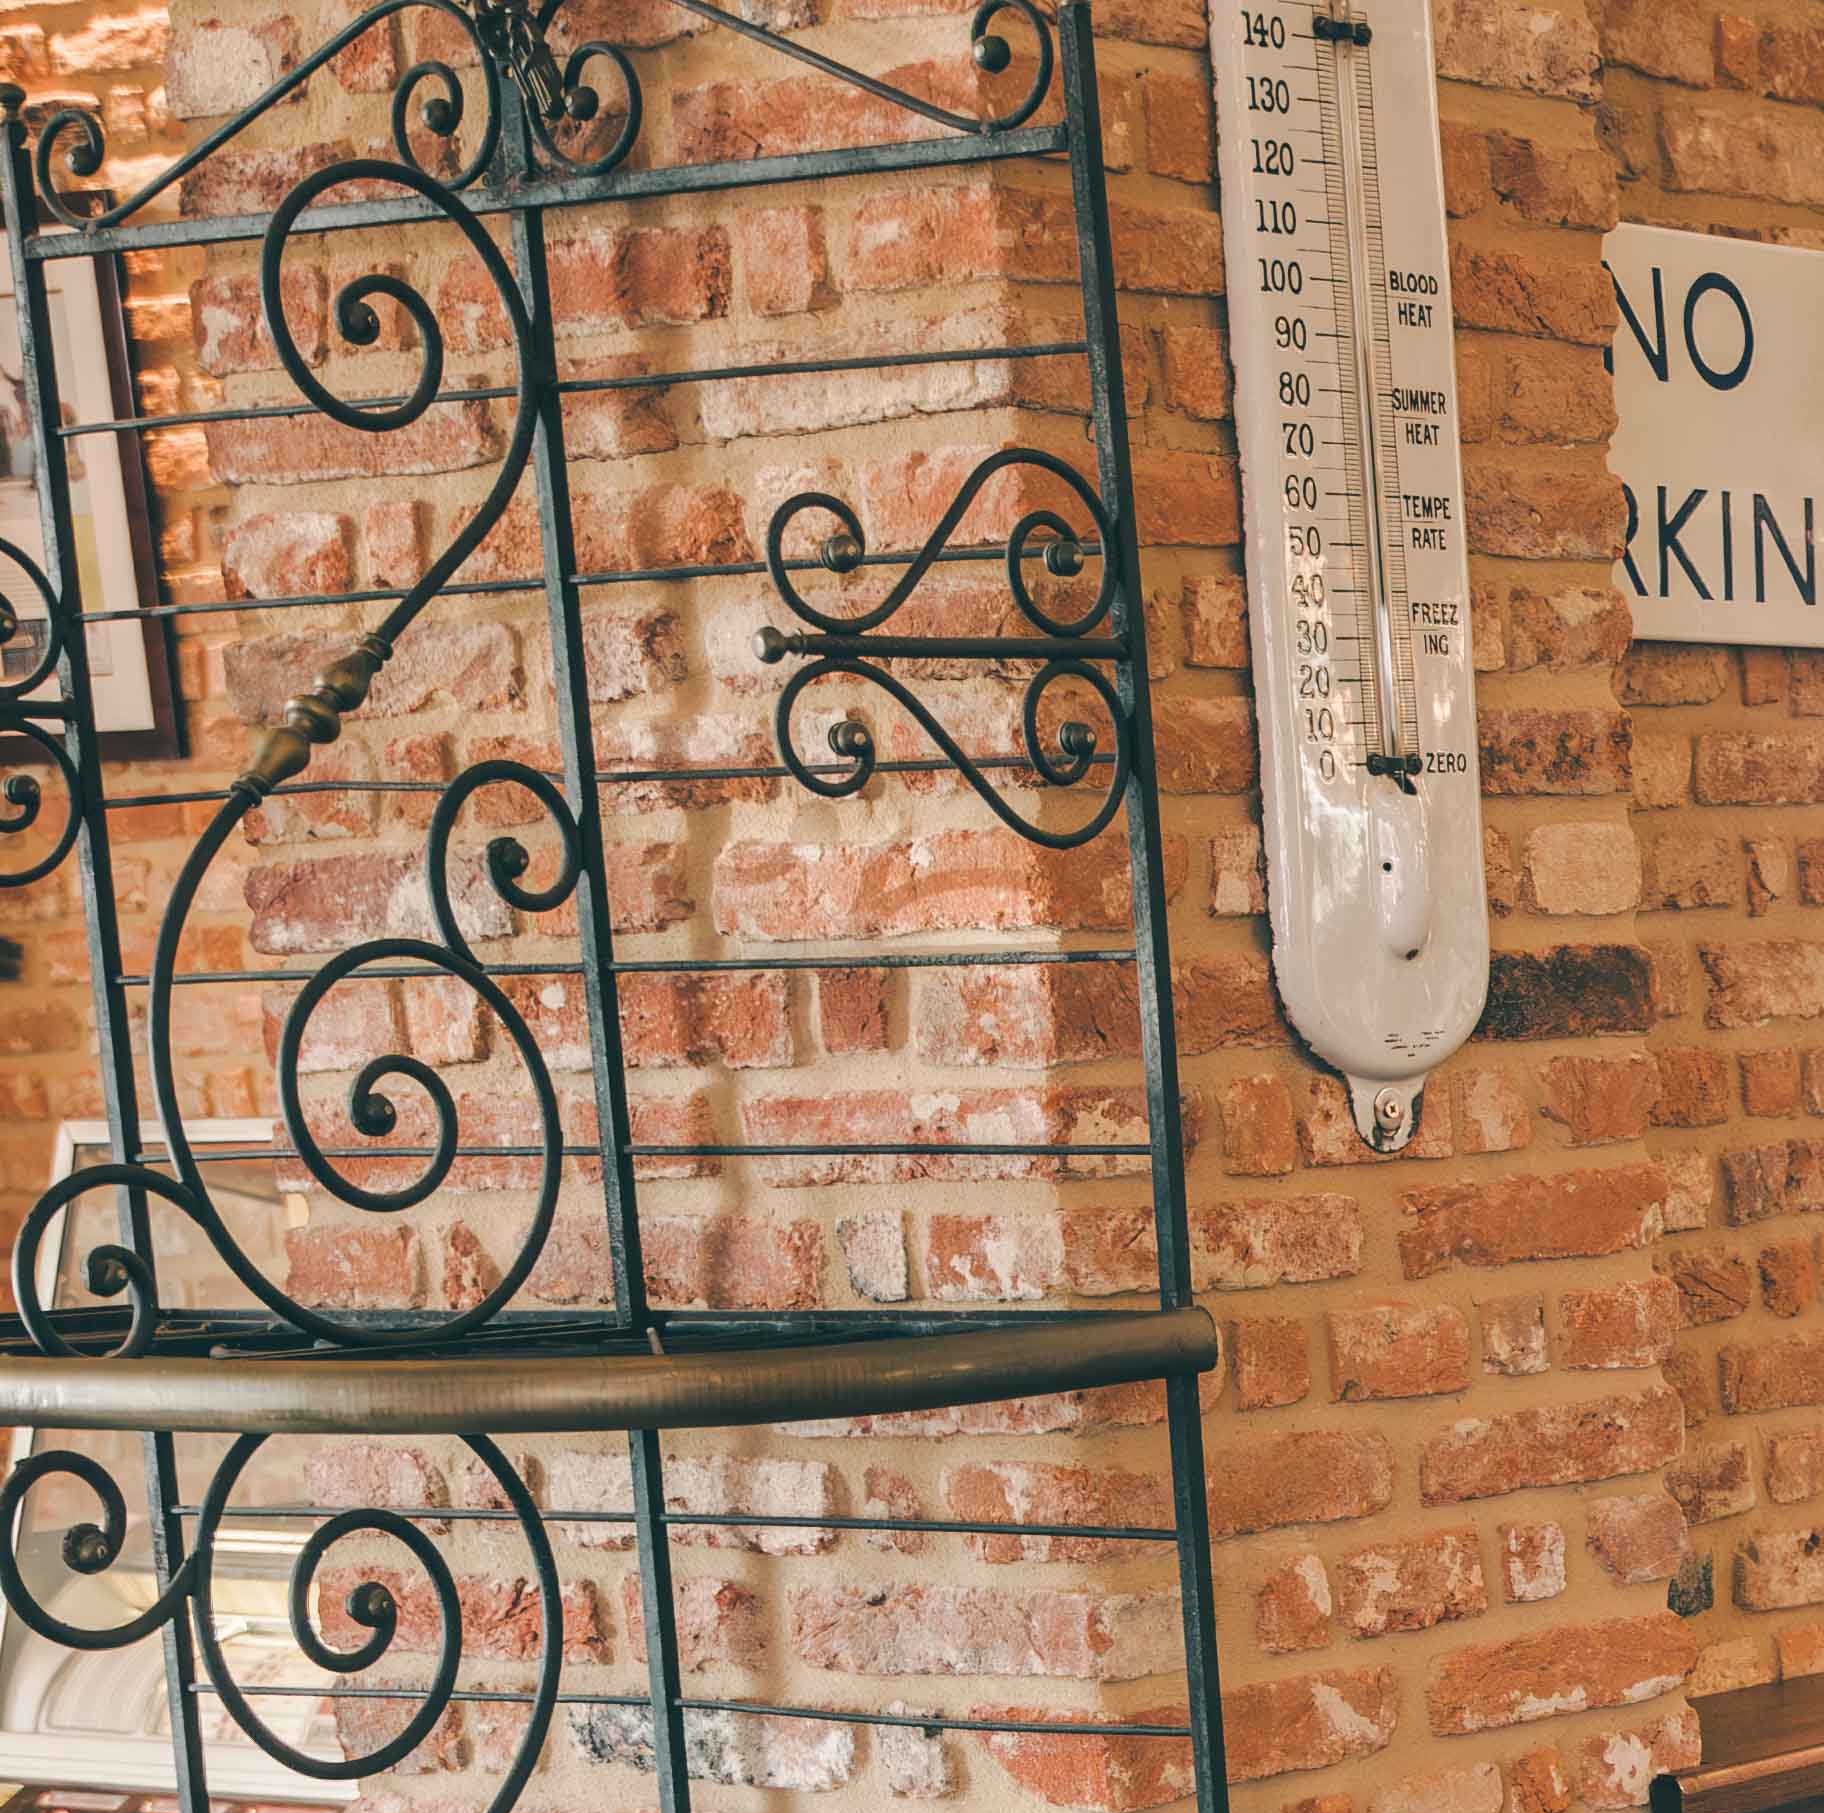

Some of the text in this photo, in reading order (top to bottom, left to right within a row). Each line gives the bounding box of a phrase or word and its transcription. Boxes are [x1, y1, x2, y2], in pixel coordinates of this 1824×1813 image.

[1241, 10, 1286, 49] 140
[1246, 76, 1290, 114] 130
[1251, 139, 1294, 177] 120
[1255, 199, 1297, 235] 110
[1258, 258, 1302, 295] 100
[1389, 270, 1439, 296] BLOOD
[1398, 302, 1433, 329] HEAT
[1600, 259, 1754, 391] NO
[1275, 316, 1307, 351] 90
[1279, 373, 1311, 406] 80
[1392, 388, 1447, 415] SUMMER
[1282, 423, 1314, 457] 70
[1405, 422, 1440, 447] HEAT
[1285, 474, 1317, 510] 60
[1403, 494, 1451, 520] TEMPE
[1289, 525, 1321, 557] 50
[1412, 528, 1447, 551] RATE
[1290, 574, 1325, 607] 40
[1412, 602, 1459, 626] FREEZ
[1296, 620, 1327, 655] 30
[1424, 634, 1449, 656] ING
[1300, 665, 1330, 699] 20
[1304, 707, 1334, 743] 10
[1320, 750, 1335, 783] 0
[1426, 752, 1467, 774] ZERO
